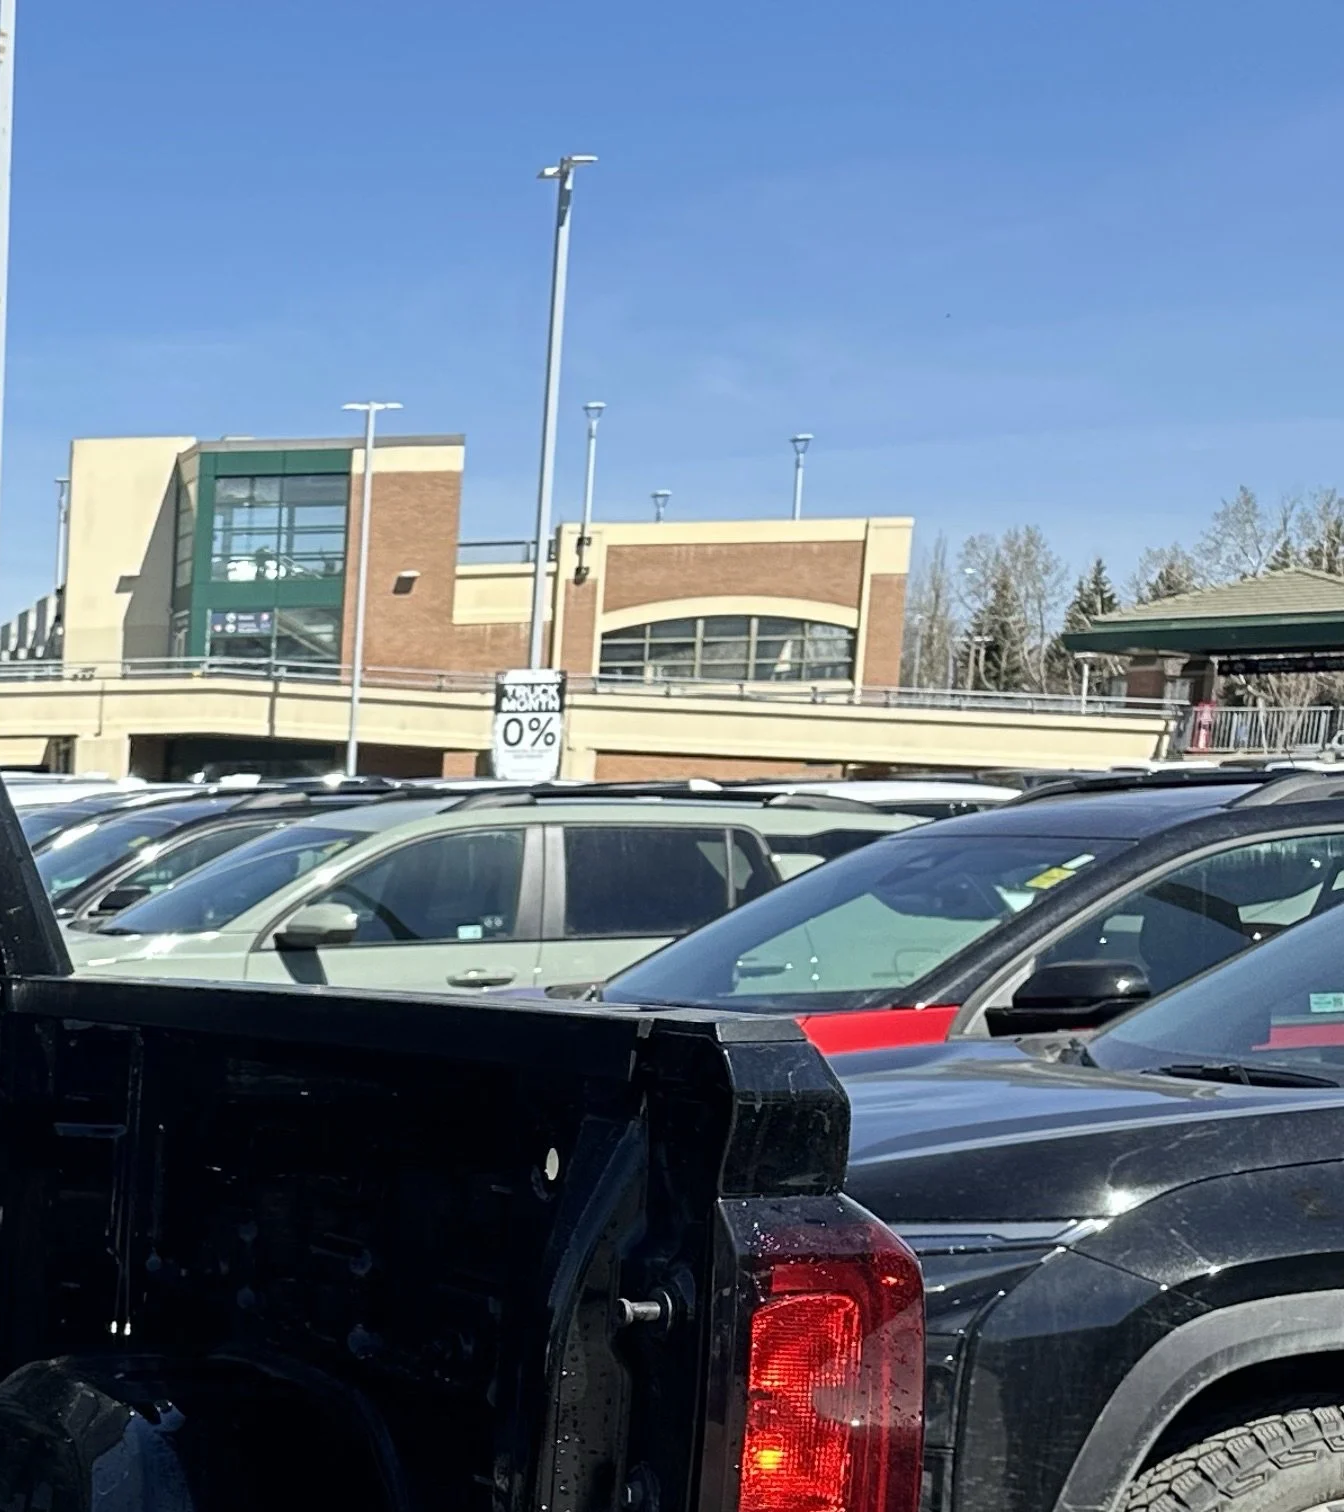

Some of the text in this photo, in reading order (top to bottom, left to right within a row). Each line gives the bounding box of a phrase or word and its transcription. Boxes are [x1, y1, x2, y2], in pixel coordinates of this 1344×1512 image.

[504, 684, 560, 701] TRUCK
[501, 696, 560, 712] MONTH
[503, 717, 556, 747] 0%
